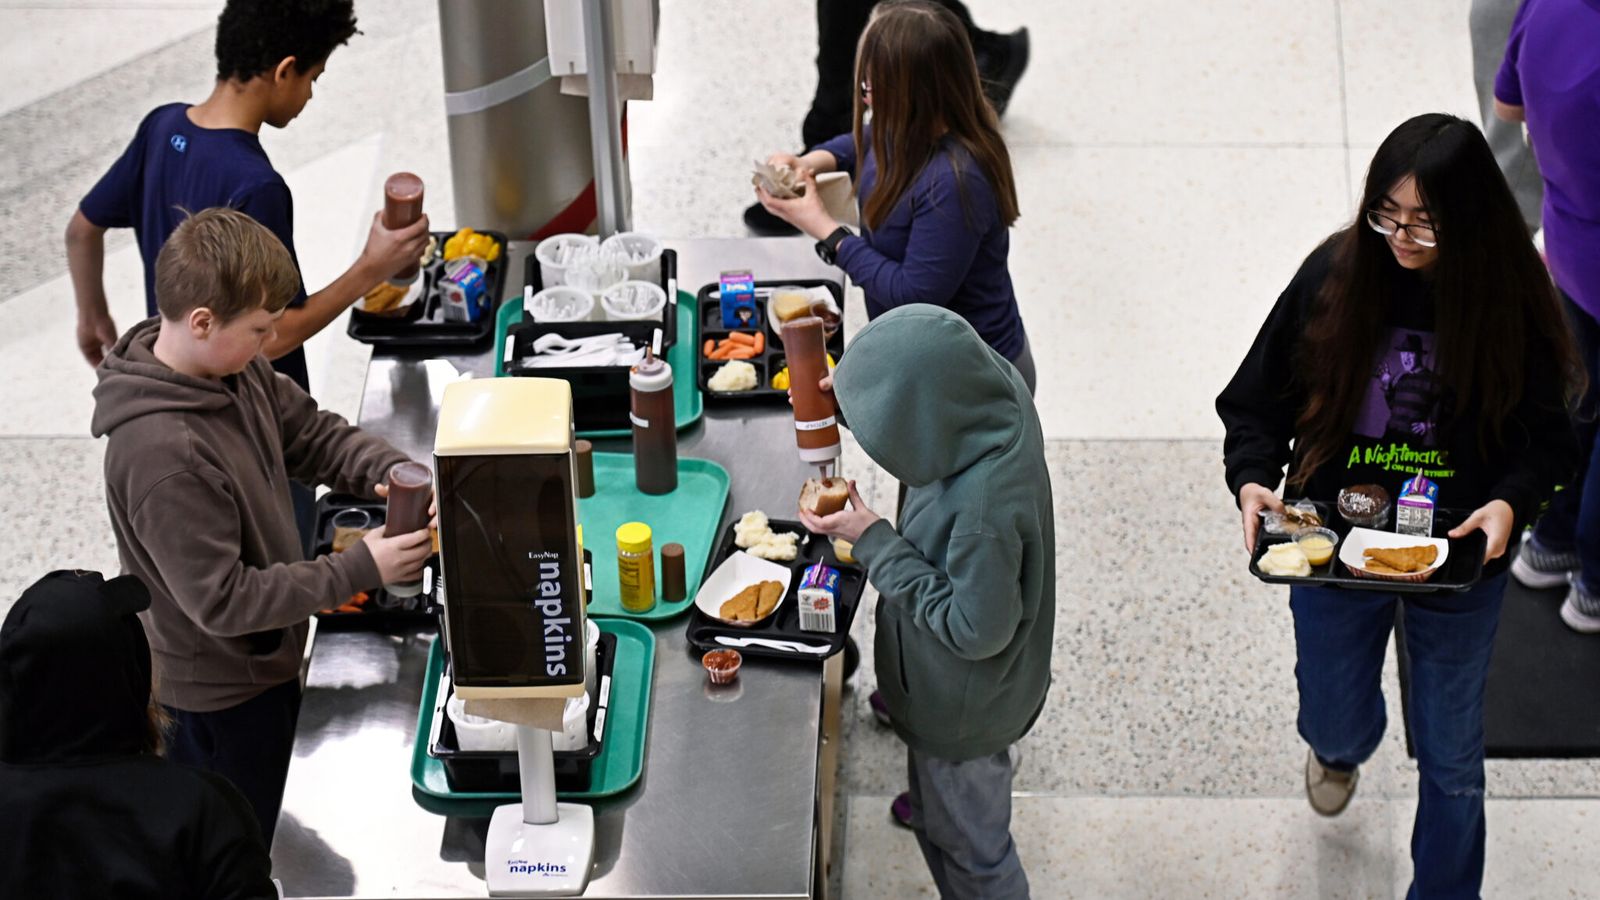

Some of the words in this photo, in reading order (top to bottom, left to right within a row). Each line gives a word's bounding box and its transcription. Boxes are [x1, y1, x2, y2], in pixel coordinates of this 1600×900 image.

[1347, 445, 1361, 469] A
[1391, 464, 1404, 472] ON
[1424, 469, 1456, 478] STREET
[528, 551, 559, 560] EasyNap
[535, 562, 573, 677] napkins
[510, 863, 566, 874] napkins
